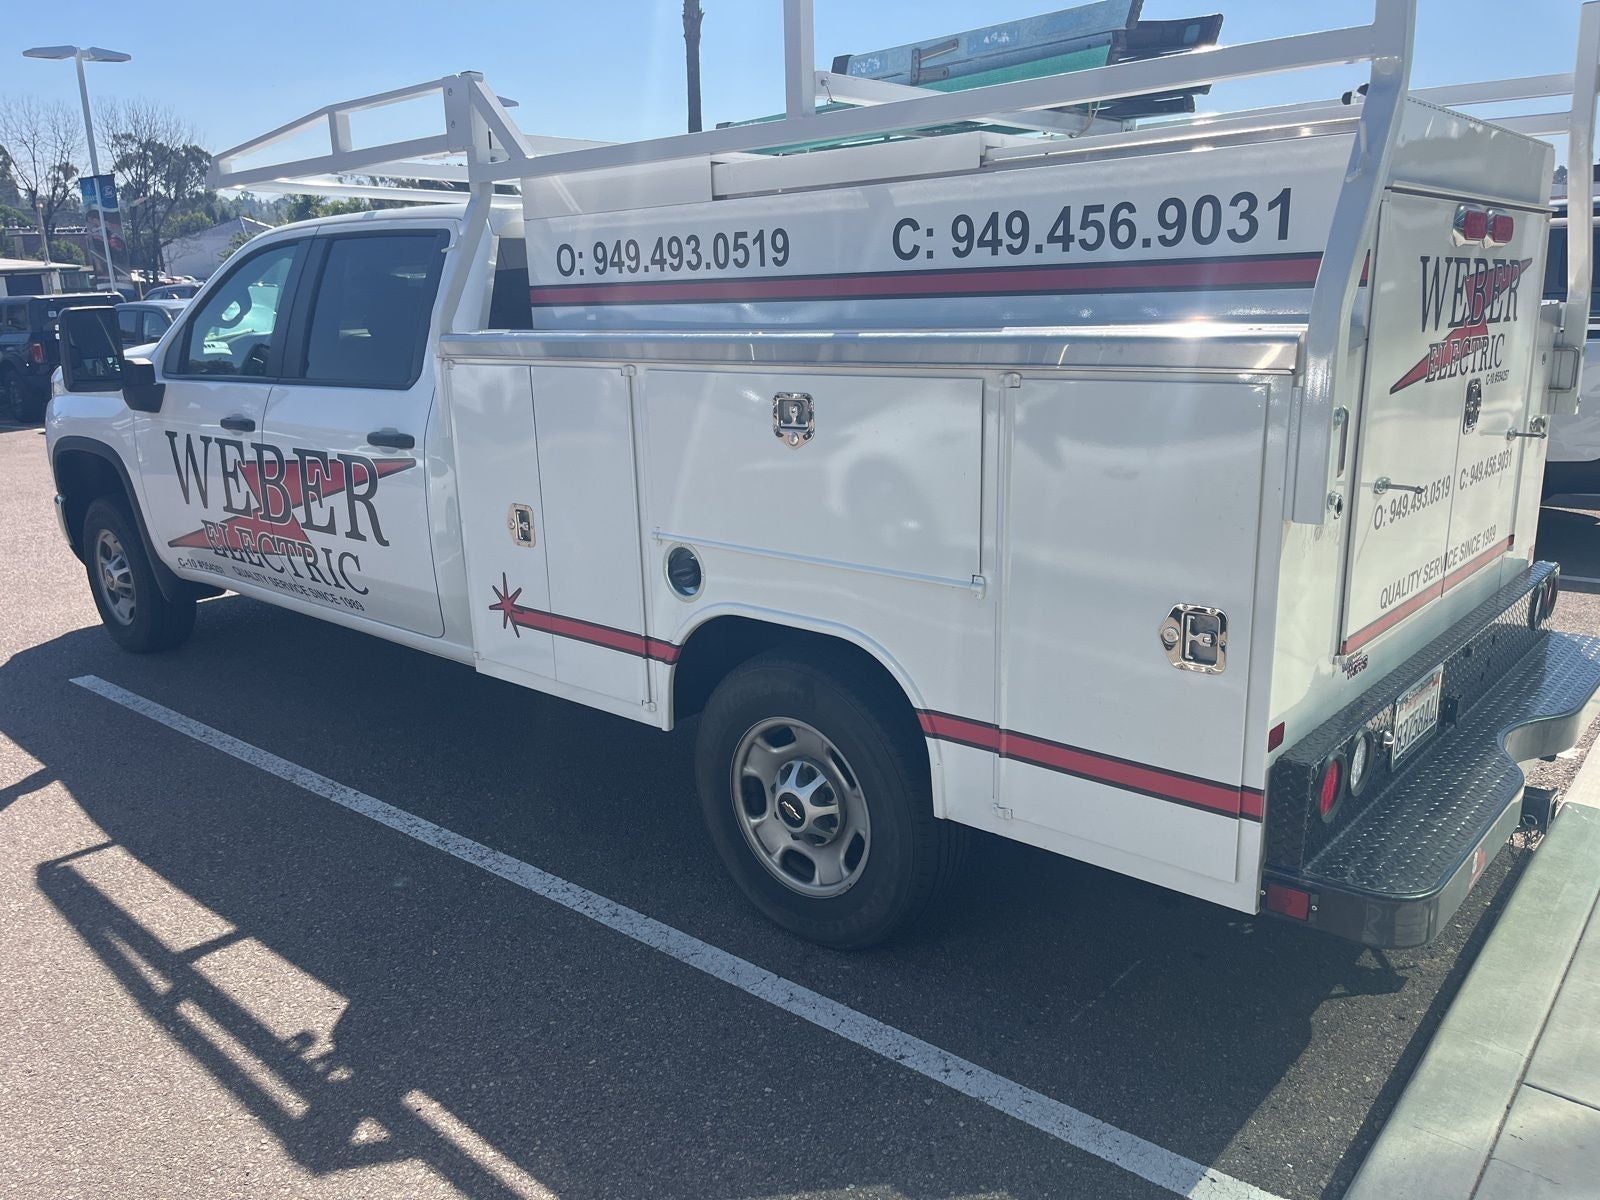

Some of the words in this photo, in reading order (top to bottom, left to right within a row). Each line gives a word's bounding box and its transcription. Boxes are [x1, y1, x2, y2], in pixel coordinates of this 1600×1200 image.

[892, 218, 934, 261] C:
[951, 187, 1292, 259] 949.456.9031
[556, 243, 585, 277] O:
[593, 228, 790, 276] 949.493.0519
[1420, 256, 1521, 332] WEBER
[1425, 333, 1505, 383] ELECTRIC
[165, 430, 390, 547] WEBER
[1459, 468, 1469, 490] C:
[1470, 448, 1512, 485] 949.456.9031
[1373, 504, 1387, 530] O:
[1389, 475, 1451, 524] 949.493.0519
[178, 557, 198, 568] C-10
[201, 519, 369, 595] ELECTRIC
[1380, 567, 1422, 609] QUALITY
[1423, 546, 1458, 583] SERVICE
[1459, 533, 1481, 562] SINCE
[1482, 524, 1496, 549] 1989
[232, 565, 271, 584] QUALITY
[267, 576, 311, 597] SERVICE
[307, 587, 341, 604] SINCE
[339, 596, 365, 611] 1989
